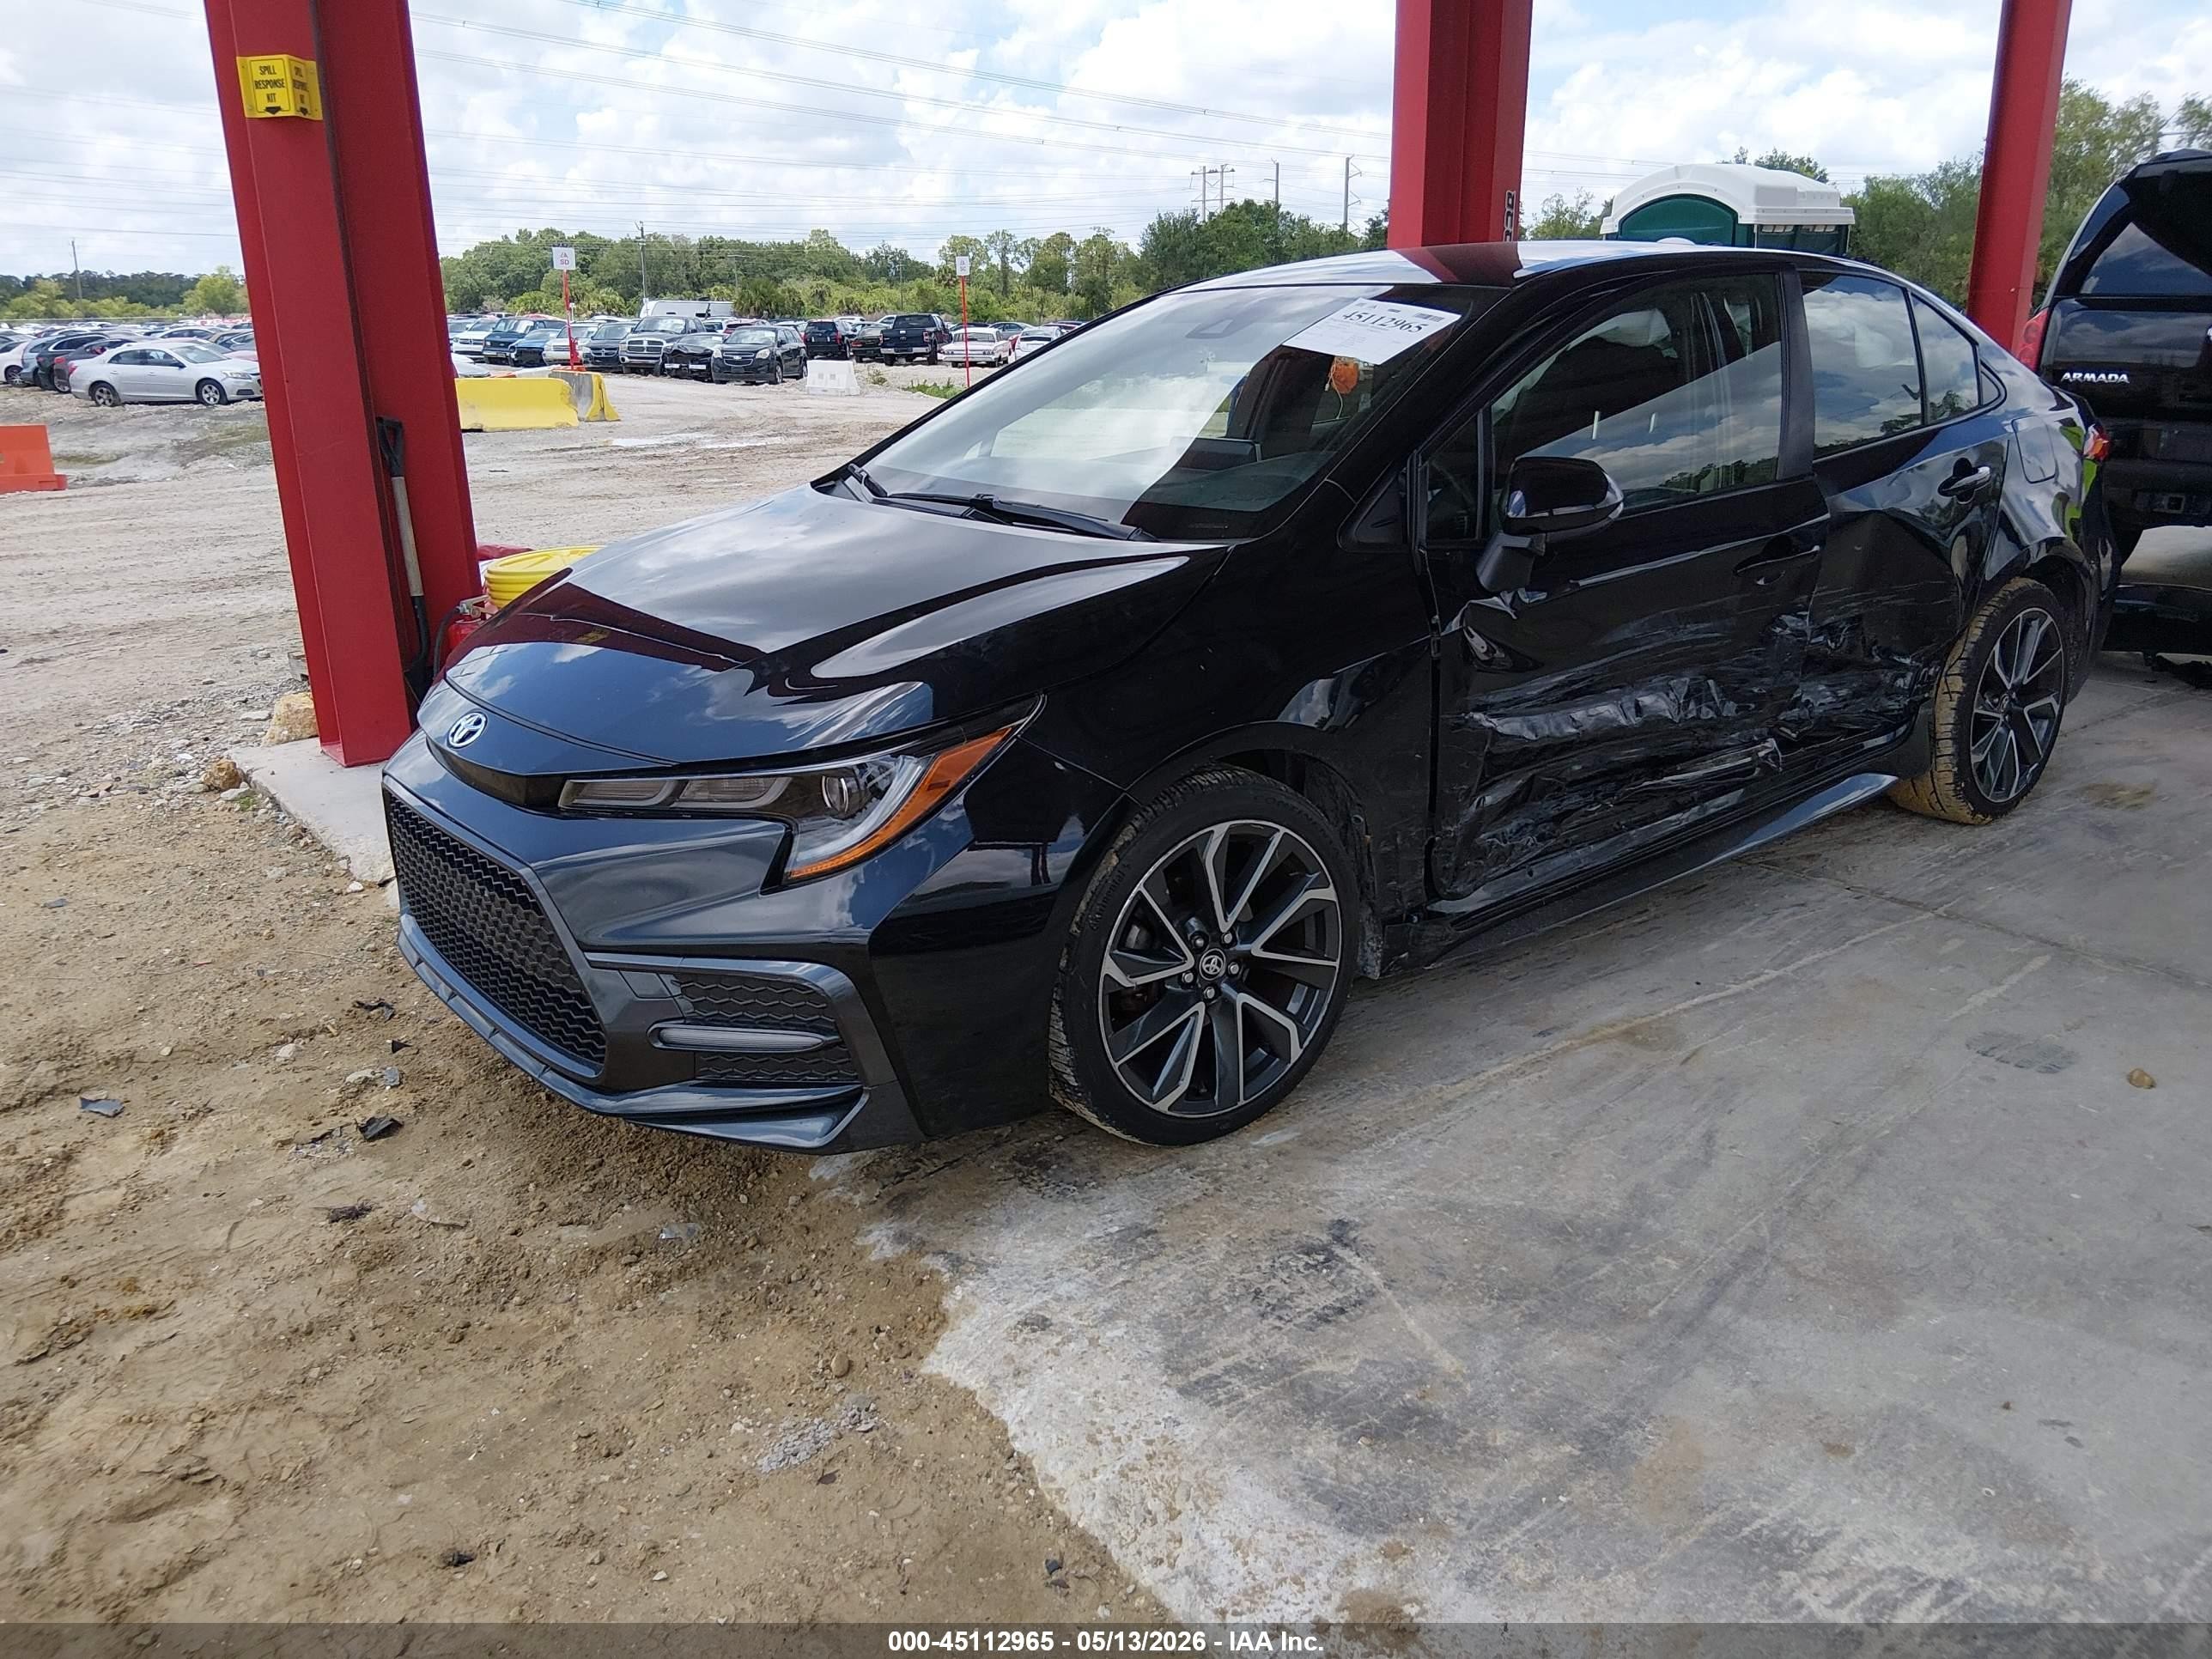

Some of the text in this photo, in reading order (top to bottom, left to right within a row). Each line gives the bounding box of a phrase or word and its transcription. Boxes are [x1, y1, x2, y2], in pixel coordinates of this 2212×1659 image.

[259, 65, 277, 76] SPILL
[254, 78, 286, 90] RESPONSE
[266, 93, 277, 103] KIT
[1342, 310, 1430, 333] 45112965
[2061, 372, 2130, 384] ARMADA
